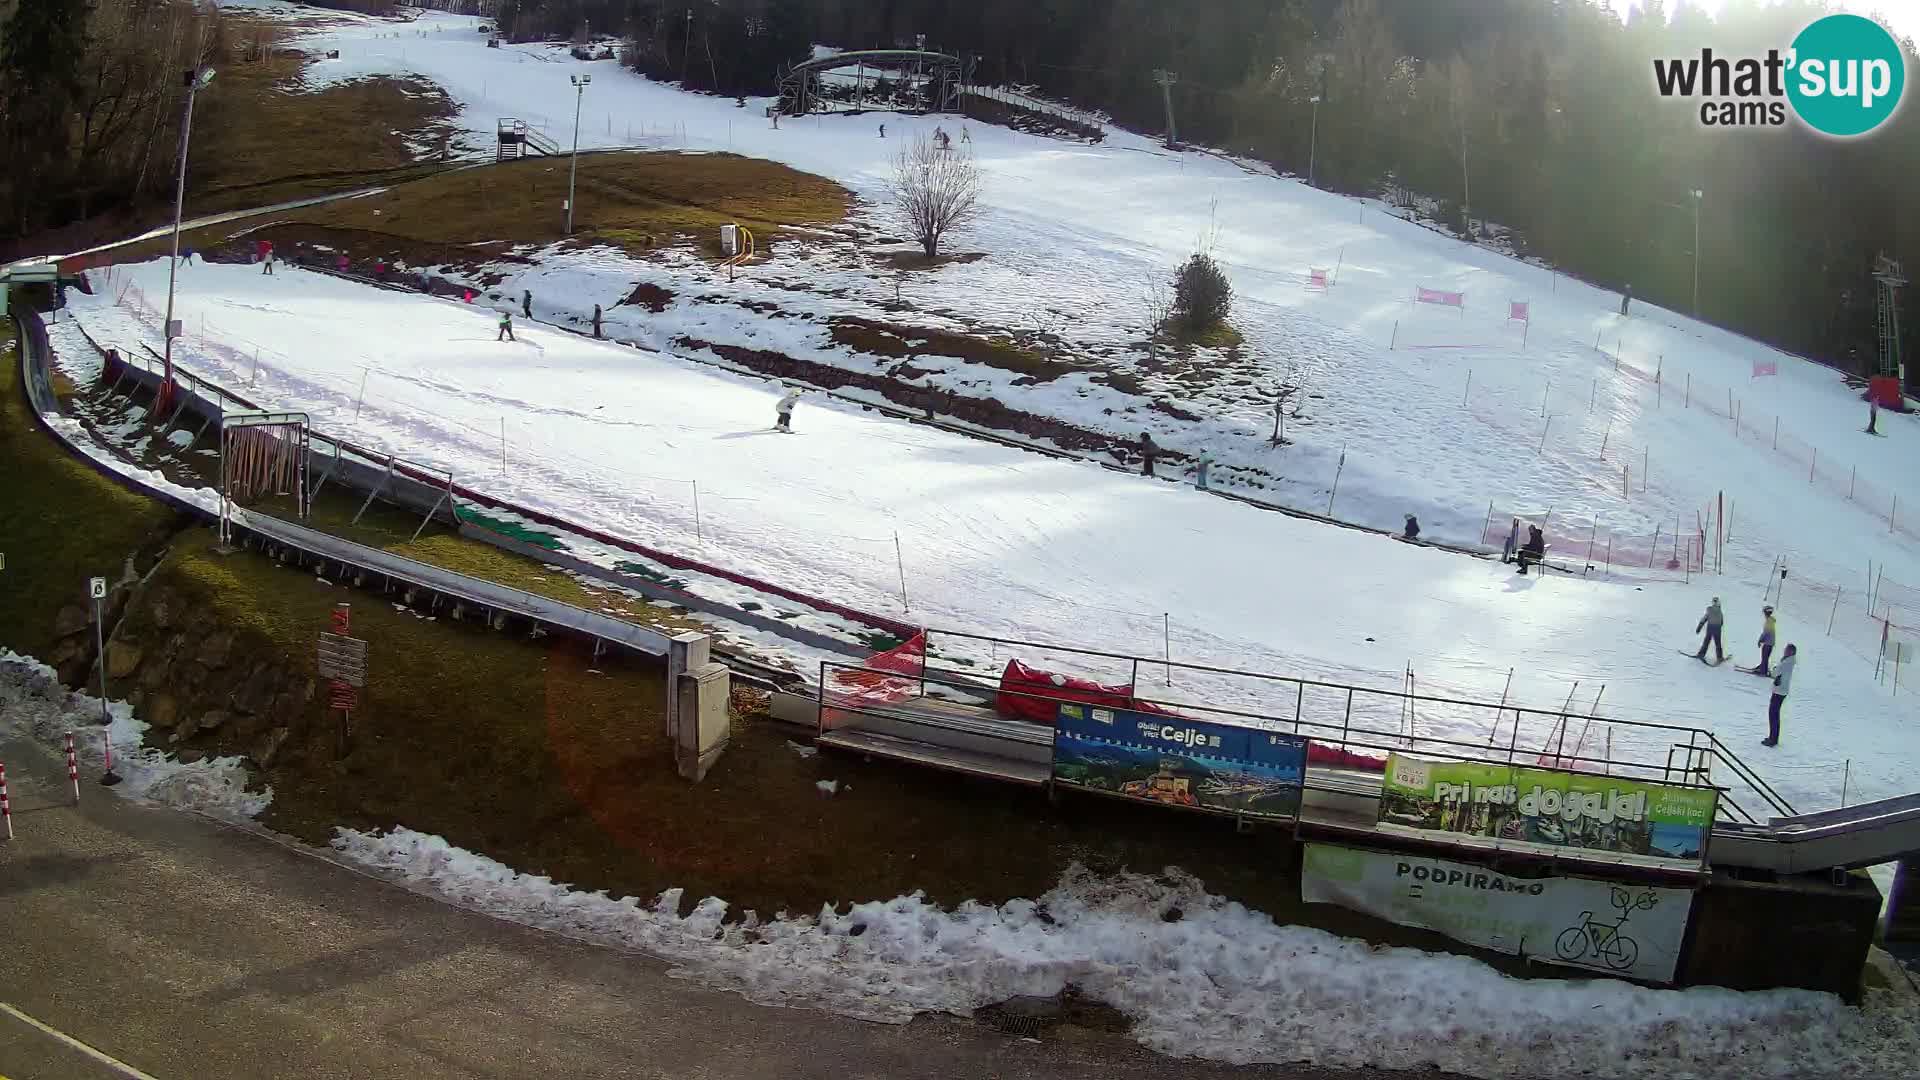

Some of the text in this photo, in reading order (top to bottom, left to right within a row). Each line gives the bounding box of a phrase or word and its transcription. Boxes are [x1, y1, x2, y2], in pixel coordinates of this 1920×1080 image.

[1160, 725, 1207, 748] Celje
[1432, 780, 1470, 803] Pri
[1474, 784, 1517, 805] nas
[1518, 785, 1646, 824] dogaja!
[1395, 862, 1545, 897] PODPIRAMO
